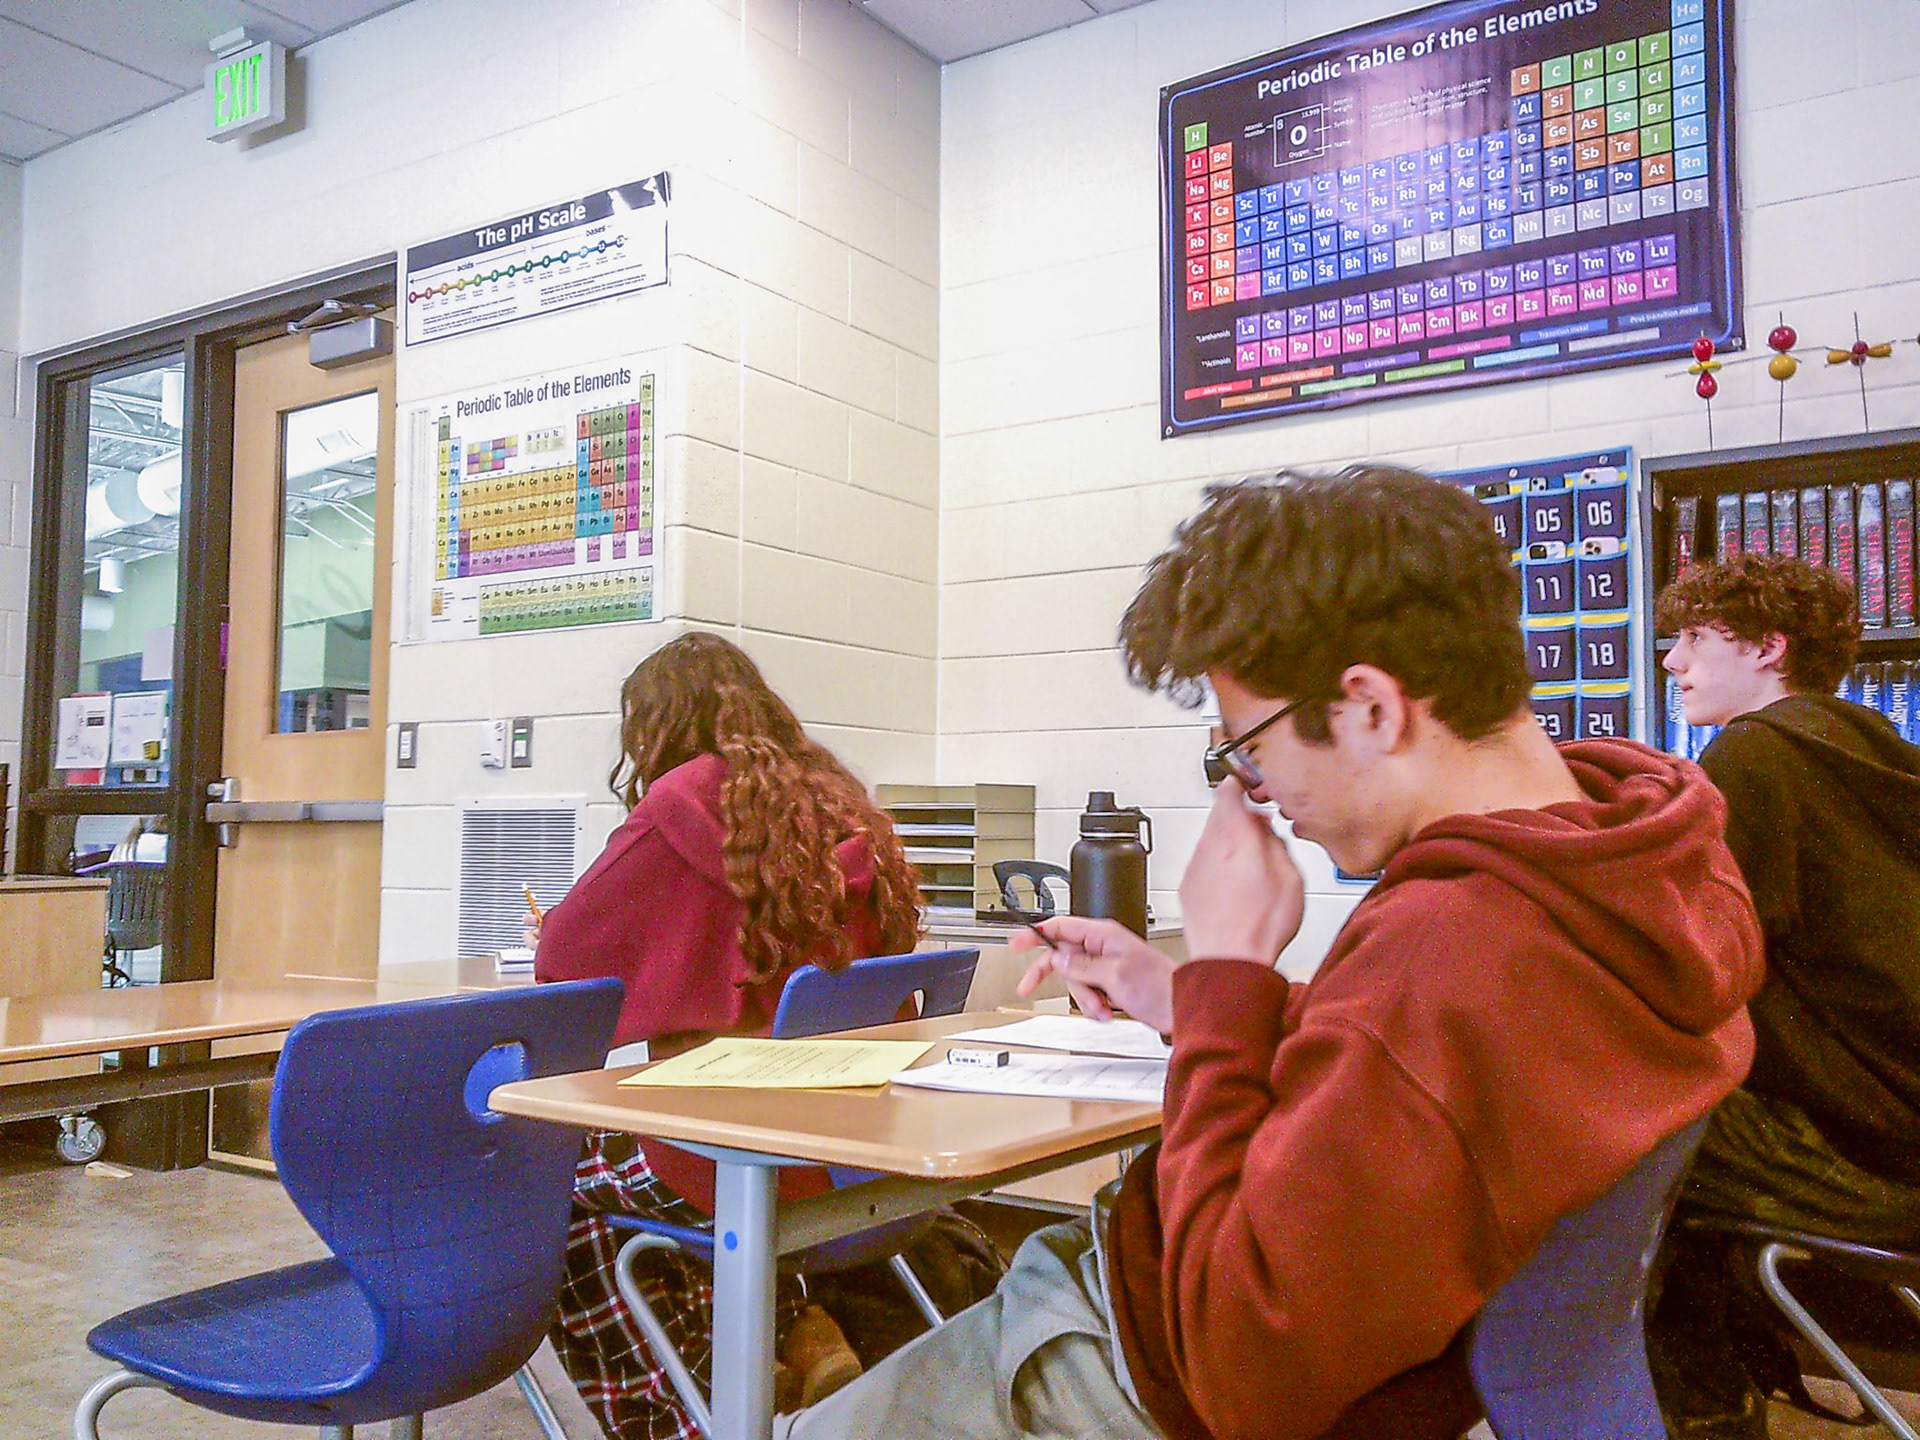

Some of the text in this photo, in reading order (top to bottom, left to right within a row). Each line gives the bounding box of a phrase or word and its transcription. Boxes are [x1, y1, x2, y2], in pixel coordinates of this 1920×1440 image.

[1677, 4, 1698, 17] He
[1257, 0, 1599, 99] Periodic Table of the Elements
[1521, 34, 1697, 85] B C N O F Ne
[215, 53, 262, 127] EXIT
[1519, 64, 1696, 115] Al Si P S Cl Ar
[1192, 131, 1200, 142] H
[1277, 119, 1284, 130] 8
[1290, 124, 1307, 146] O
[1192, 151, 1227, 169] Li Be
[1194, 95, 1698, 222] K Ca Sc Ti V Cr Mn Fe Co Ni Cu Zn Ga Ge As Se Br Kr
[1190, 178, 1230, 196] Na Mg
[1190, 126, 1698, 249] Rb Sr Y Zr Nb Mo Tc Ru Rh Pd Ag Cd In Sn Sb Te I Xe
[475, 203, 586, 247] The pH Scale
[1191, 157, 1701, 275] Cs Ba Hf Ta W Re Os Ir Pt Au Hg Tl Pb Bi Po At Rn
[1242, 246, 1668, 334] La Ce Pr Nd Pm Sm Eu Gd Tb Dy Ho Er Tm Yb Lu
[457, 367, 631, 417] Periodic Table of the Elements
[1493, 500, 1613, 538] 4 05 06
[1535, 572, 1614, 601] 11 12
[1896, 518, 1915, 612] CHEMISTRY
[1537, 642, 1615, 669] 17 18
[1588, 712, 1616, 737] 24
[1888, 682, 1909, 725] Biology
